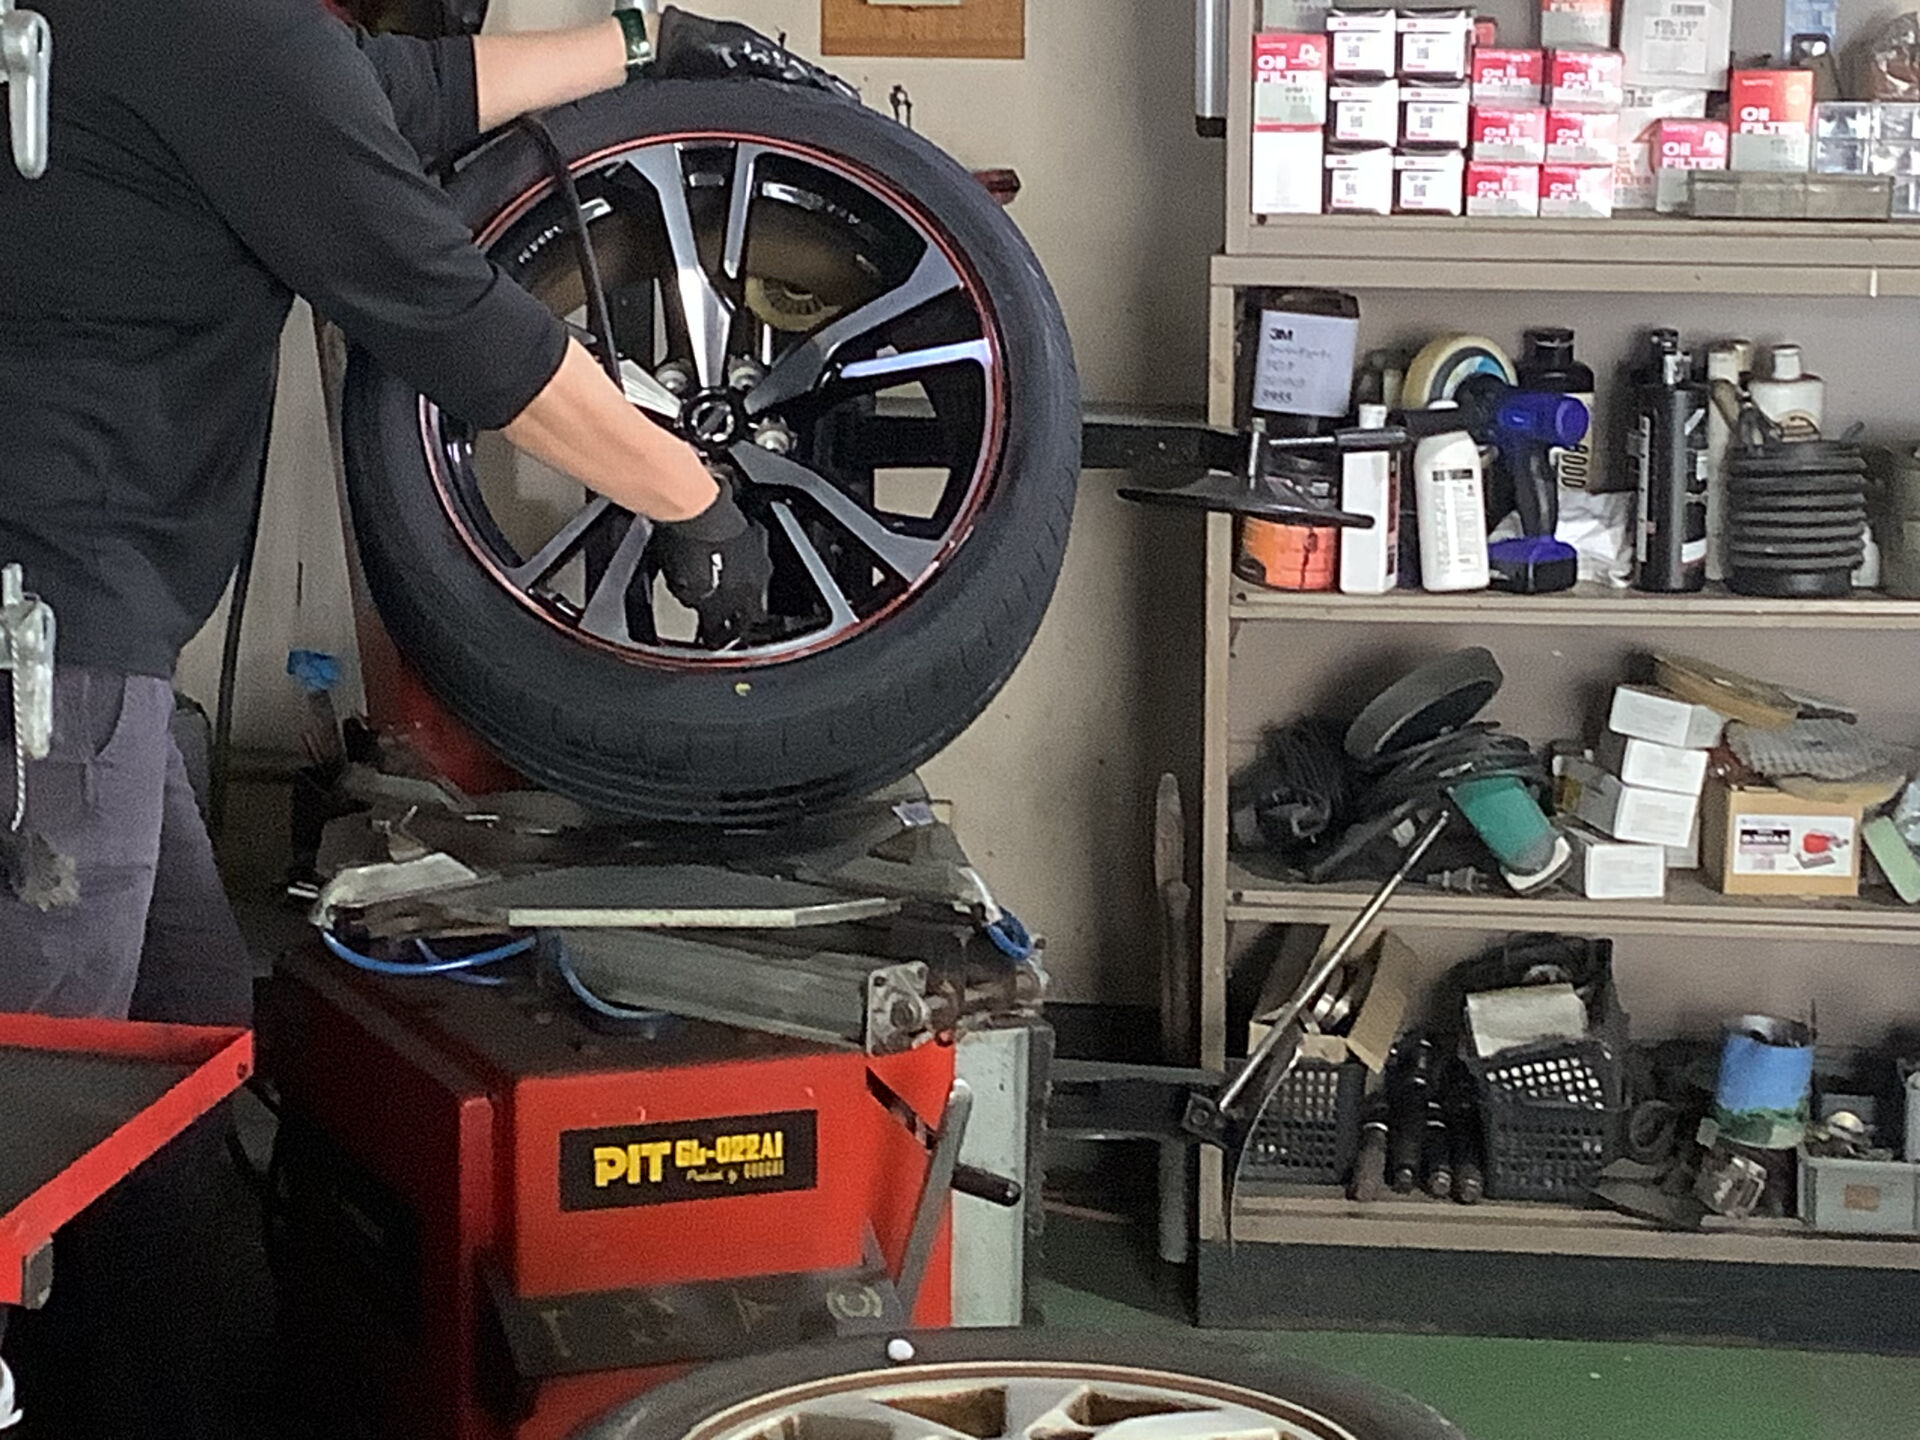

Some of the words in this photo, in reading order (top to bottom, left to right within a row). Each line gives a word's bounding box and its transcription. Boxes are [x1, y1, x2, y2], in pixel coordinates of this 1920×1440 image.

[1257, 70, 1321, 83] FILT
[1740, 107, 1770, 121] Oil
[1740, 121, 1804, 135] FILT
[1662, 142, 1690, 156] Oil
[1269, 327, 1293, 341] 3M
[594, 1141, 672, 1187] PIT
